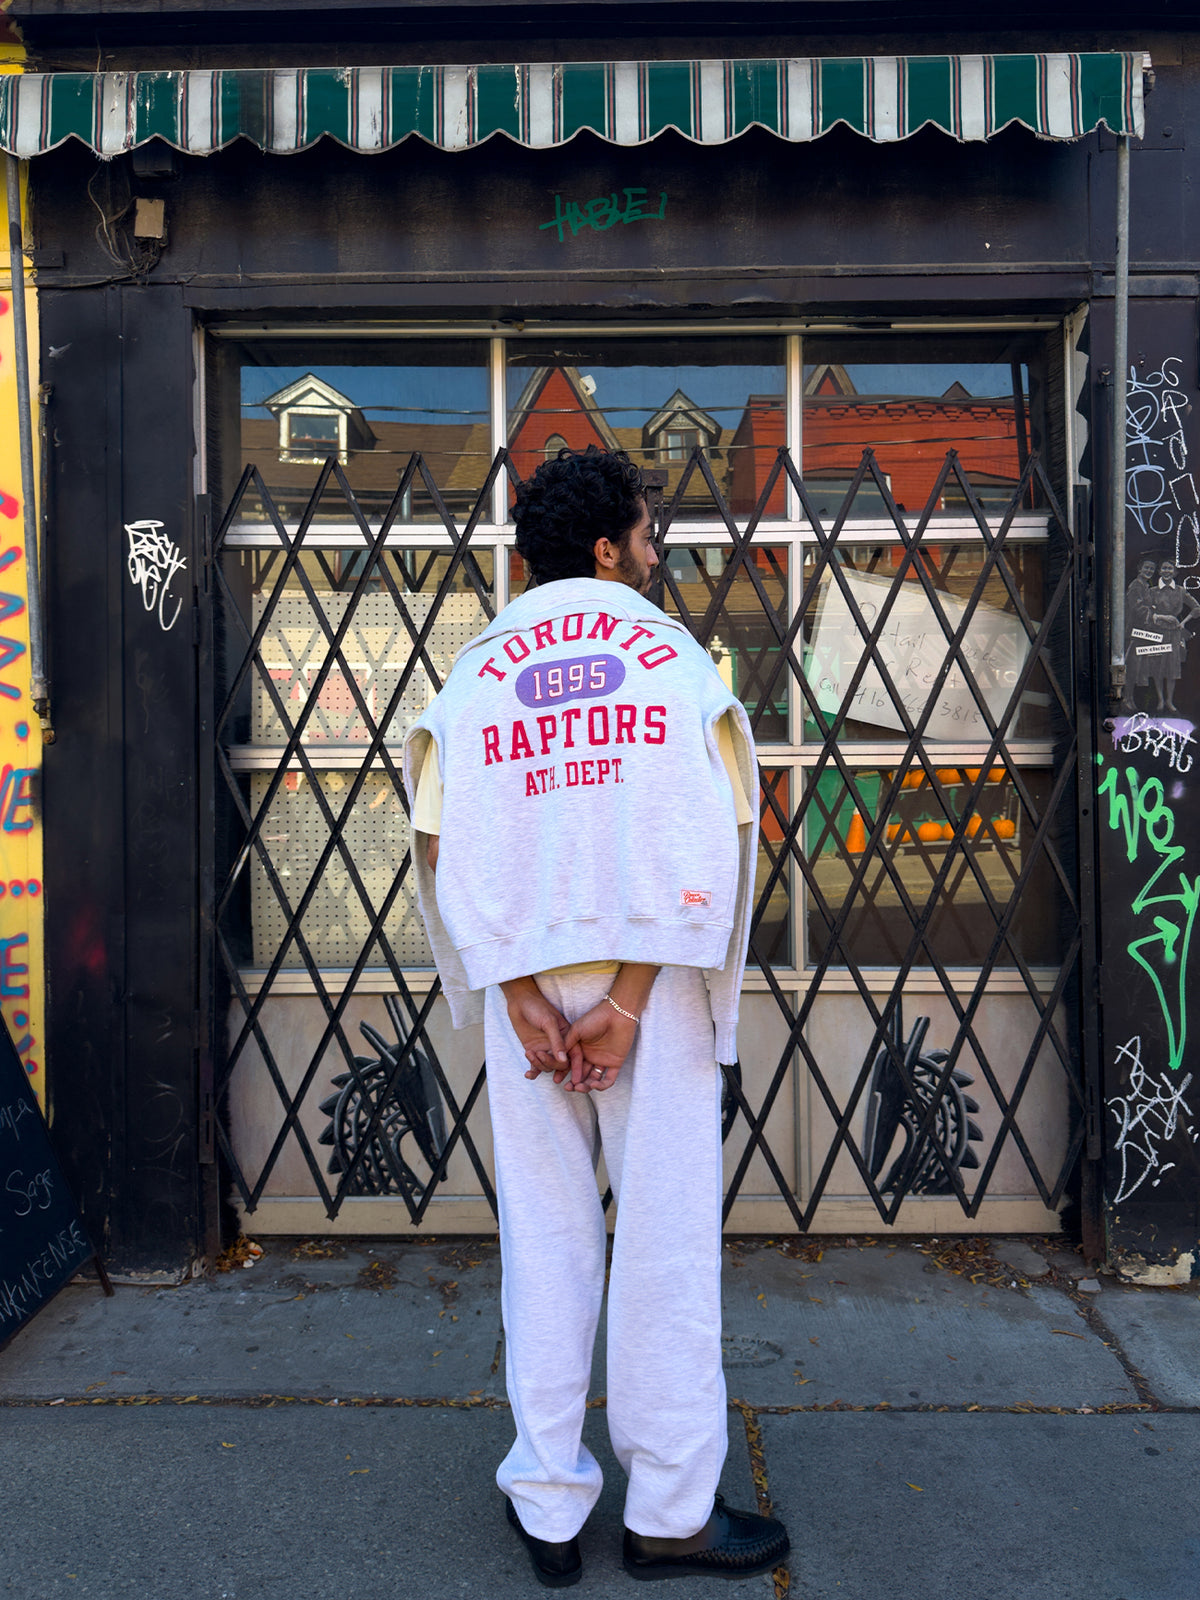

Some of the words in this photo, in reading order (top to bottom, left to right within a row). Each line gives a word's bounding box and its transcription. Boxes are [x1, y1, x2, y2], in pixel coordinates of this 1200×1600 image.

[478, 612, 679, 682] TORONTO
[533, 660, 607, 700] 1995
[482, 704, 667, 766] RAPTORS
[525, 766, 560, 797] ATH.
[565, 758, 624, 788] DEPT.
